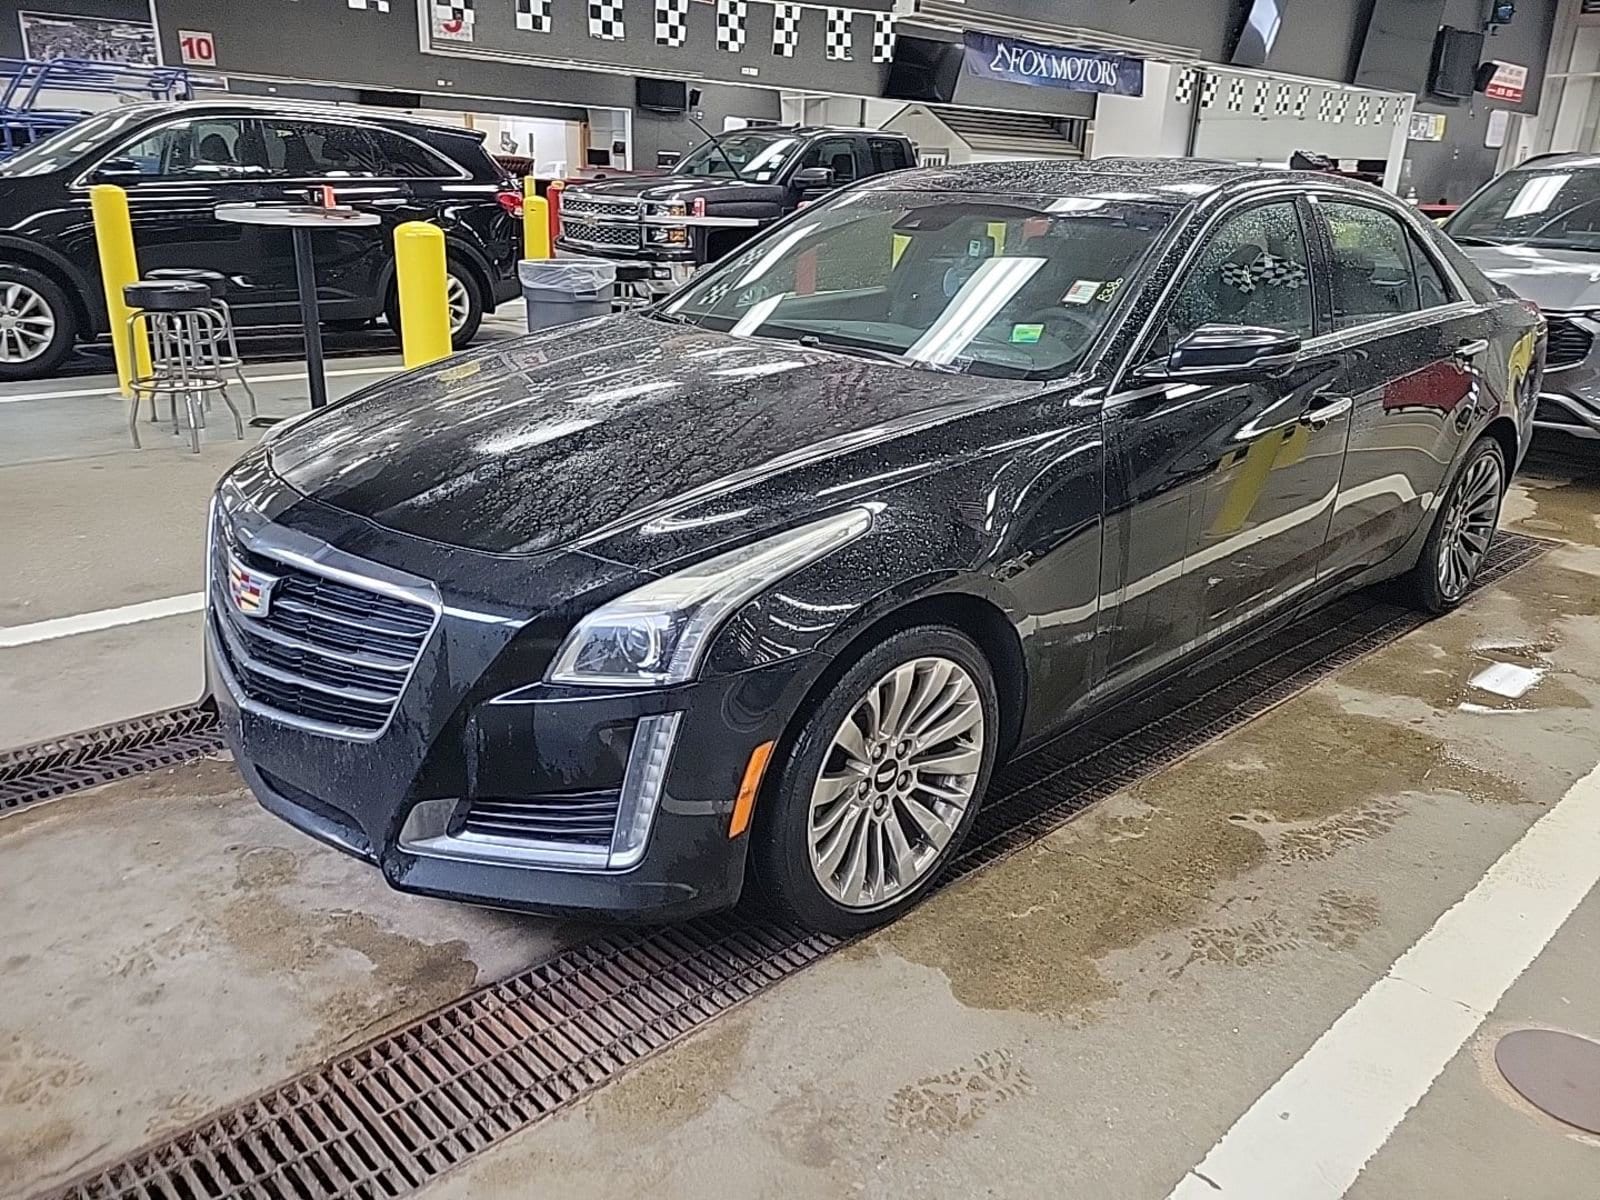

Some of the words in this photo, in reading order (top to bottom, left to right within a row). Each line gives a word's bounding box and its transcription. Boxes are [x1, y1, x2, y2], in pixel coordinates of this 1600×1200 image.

[182, 37, 213, 60] 10
[1008, 47, 1049, 77] FOX
[1050, 54, 1119, 87] MOTORS
